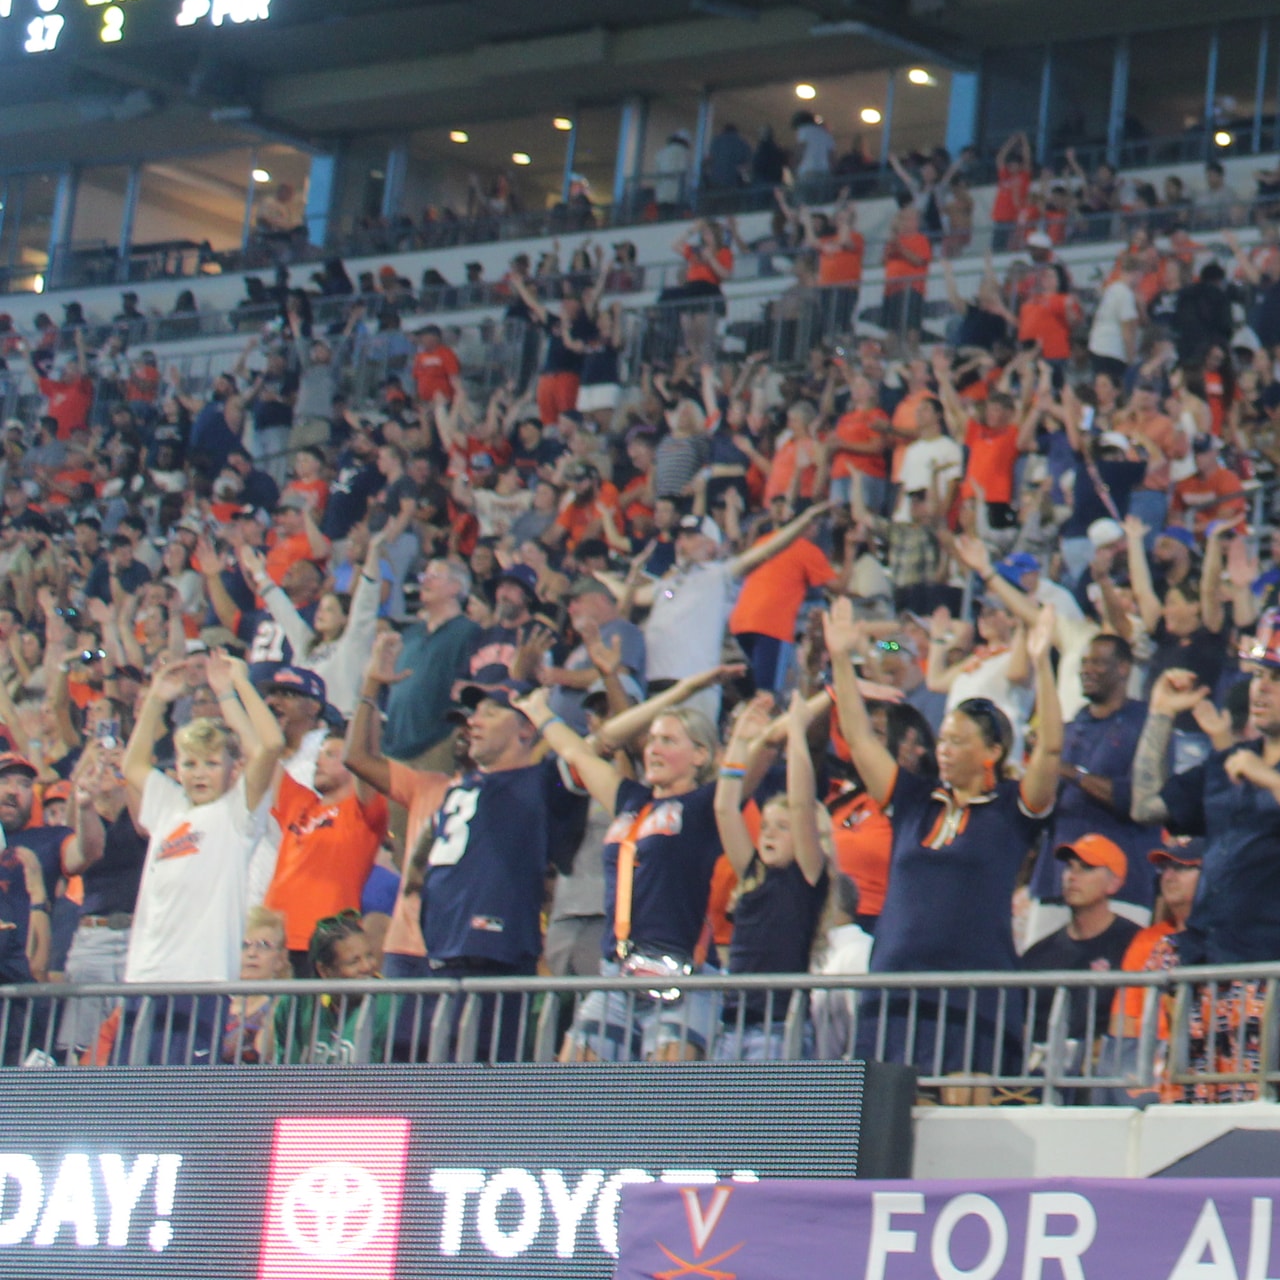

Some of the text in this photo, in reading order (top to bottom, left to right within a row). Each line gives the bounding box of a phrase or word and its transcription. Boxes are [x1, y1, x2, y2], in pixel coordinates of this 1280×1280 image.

[24, 14, 64, 53] 17
[101, 6, 124, 42] 2
[251, 620, 285, 662] 21
[0, 1153, 183, 1252] DAY!
[864, 1191, 1099, 1280] FOR
